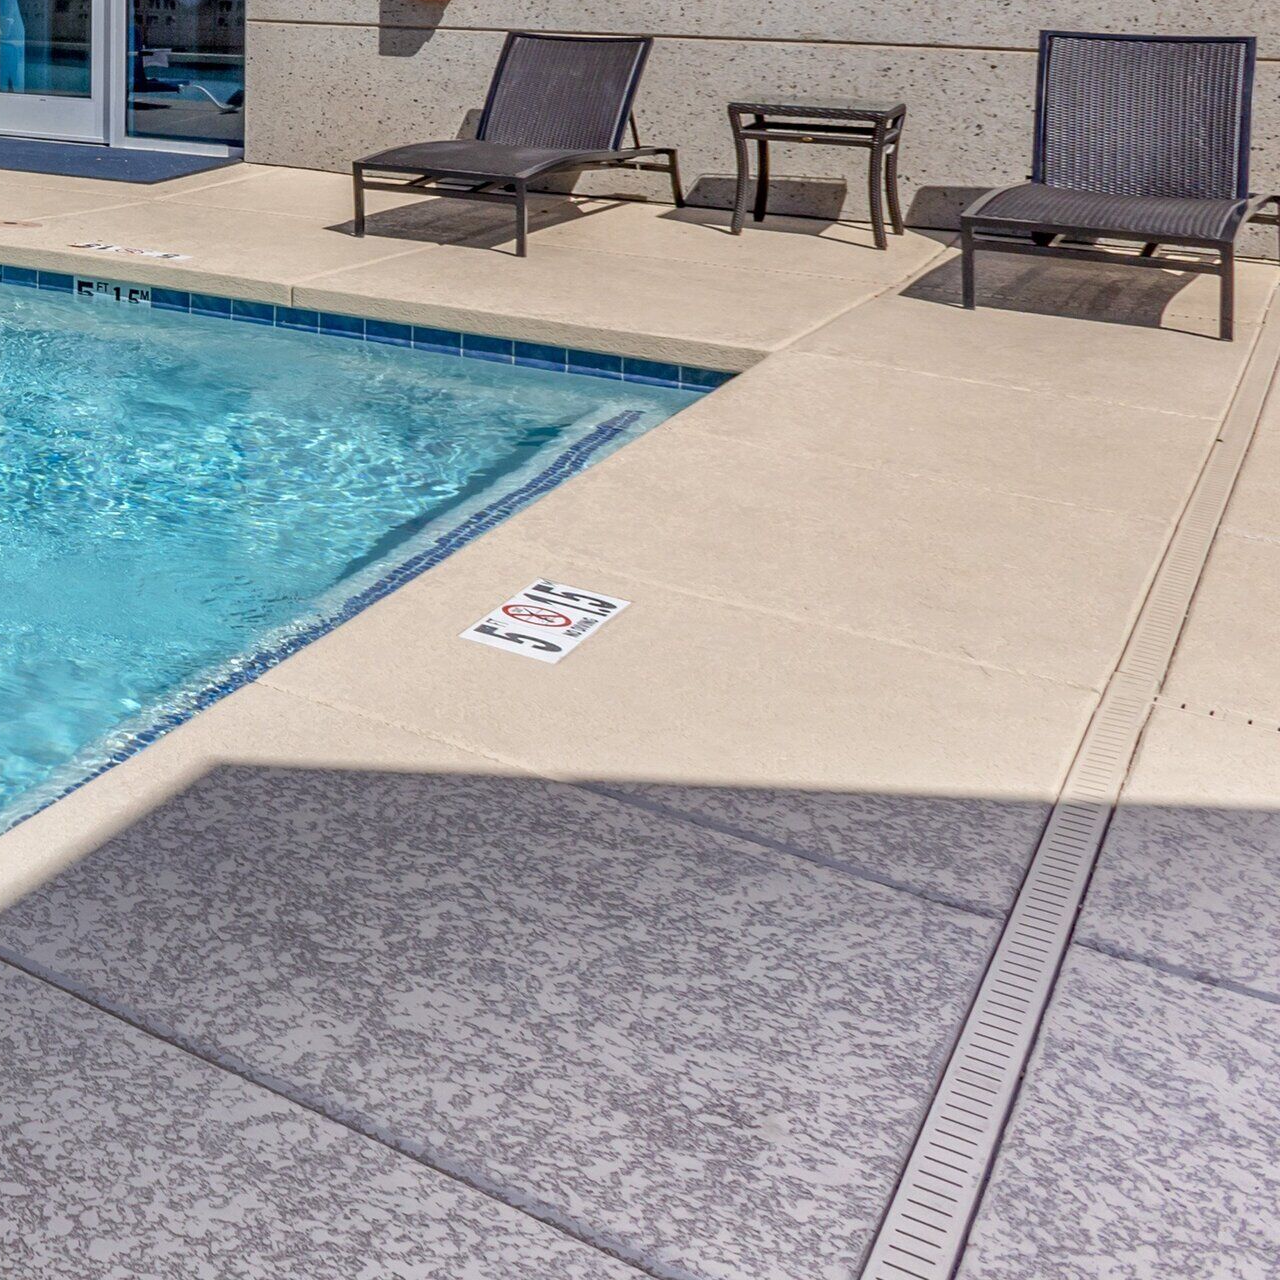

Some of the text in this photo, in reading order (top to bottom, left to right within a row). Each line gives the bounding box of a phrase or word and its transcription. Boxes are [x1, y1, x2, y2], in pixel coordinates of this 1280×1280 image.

[77, 280, 94, 297] 5
[97, 282, 109, 293] FT
[473, 623, 562, 653] 5
[523, 584, 617, 617] 1.5
